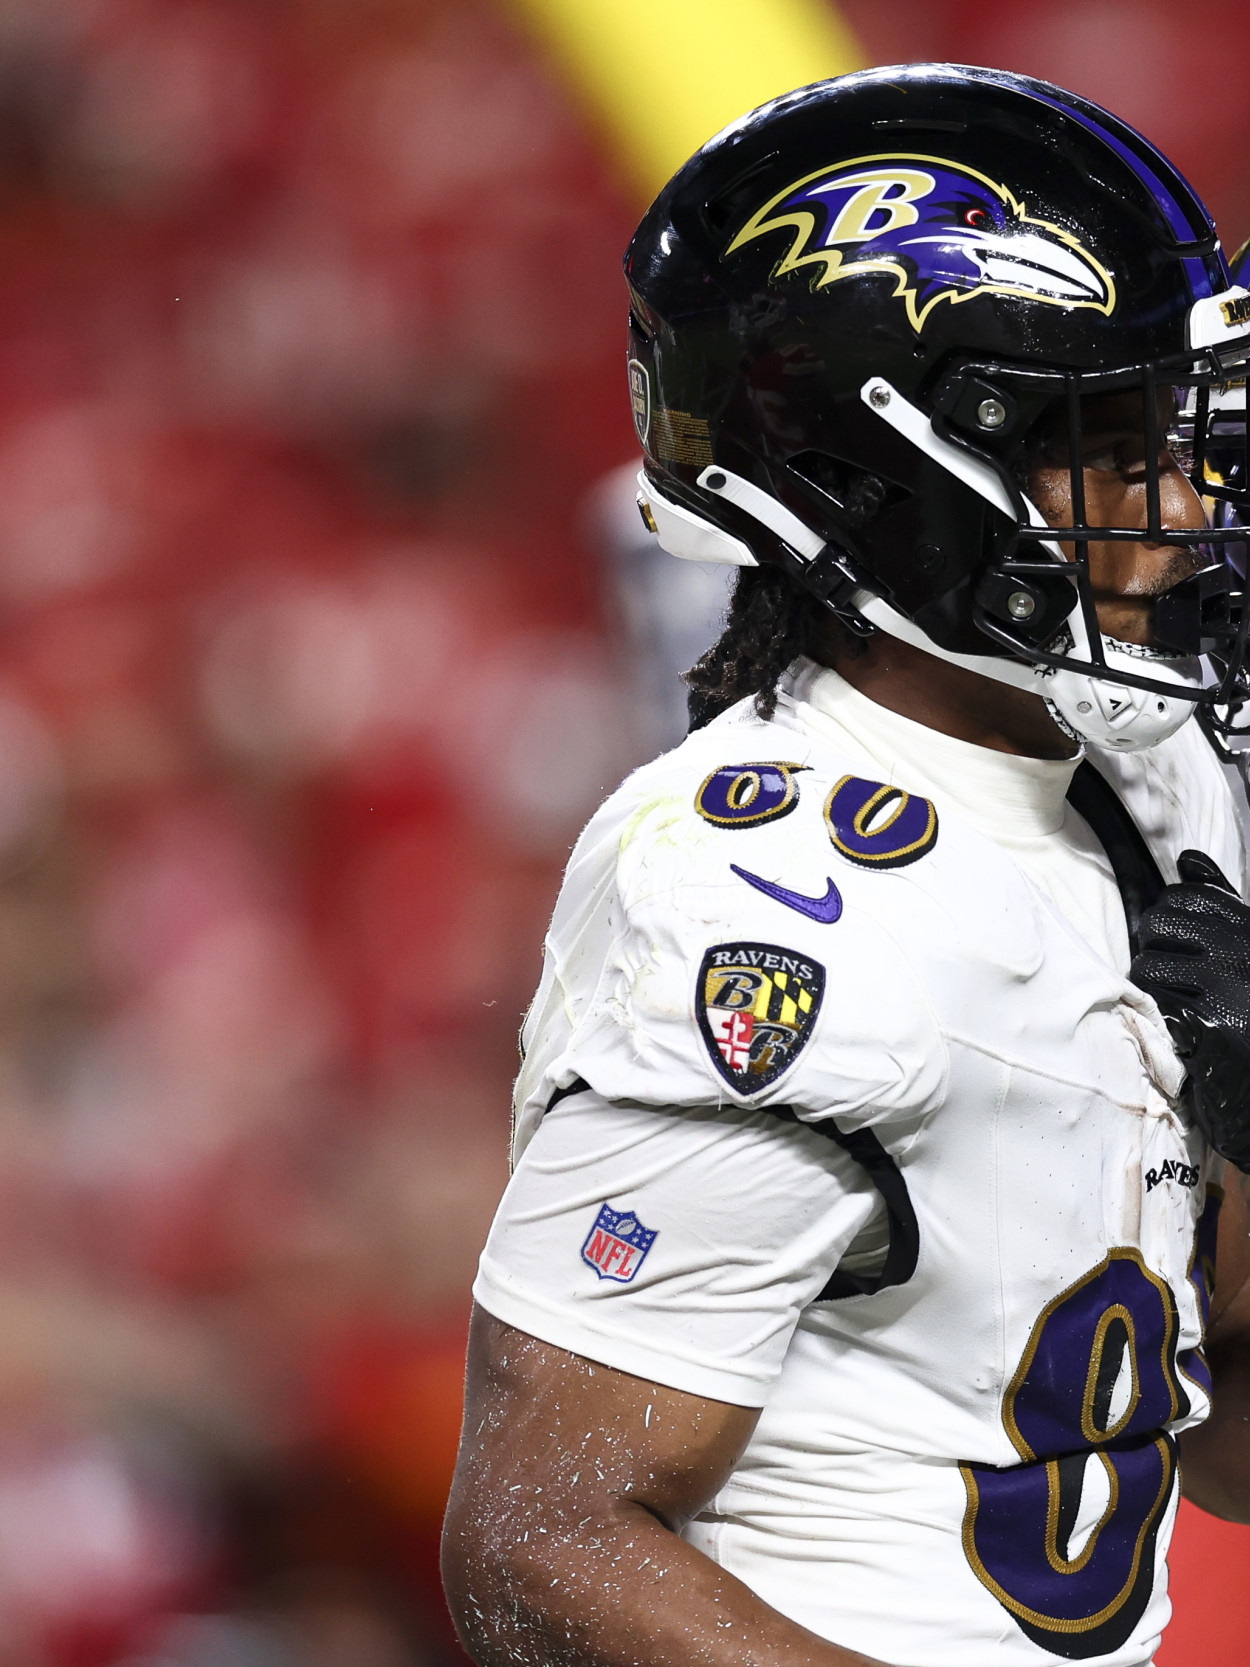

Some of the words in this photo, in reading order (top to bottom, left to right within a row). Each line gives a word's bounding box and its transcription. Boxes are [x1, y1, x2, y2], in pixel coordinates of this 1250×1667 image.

[806, 168, 936, 246] B
[711, 969, 764, 1010] B
[712, 950, 814, 980] RAVENS
[585, 1229, 637, 1278] NFL
[960, 1183, 1222, 1660] 8
